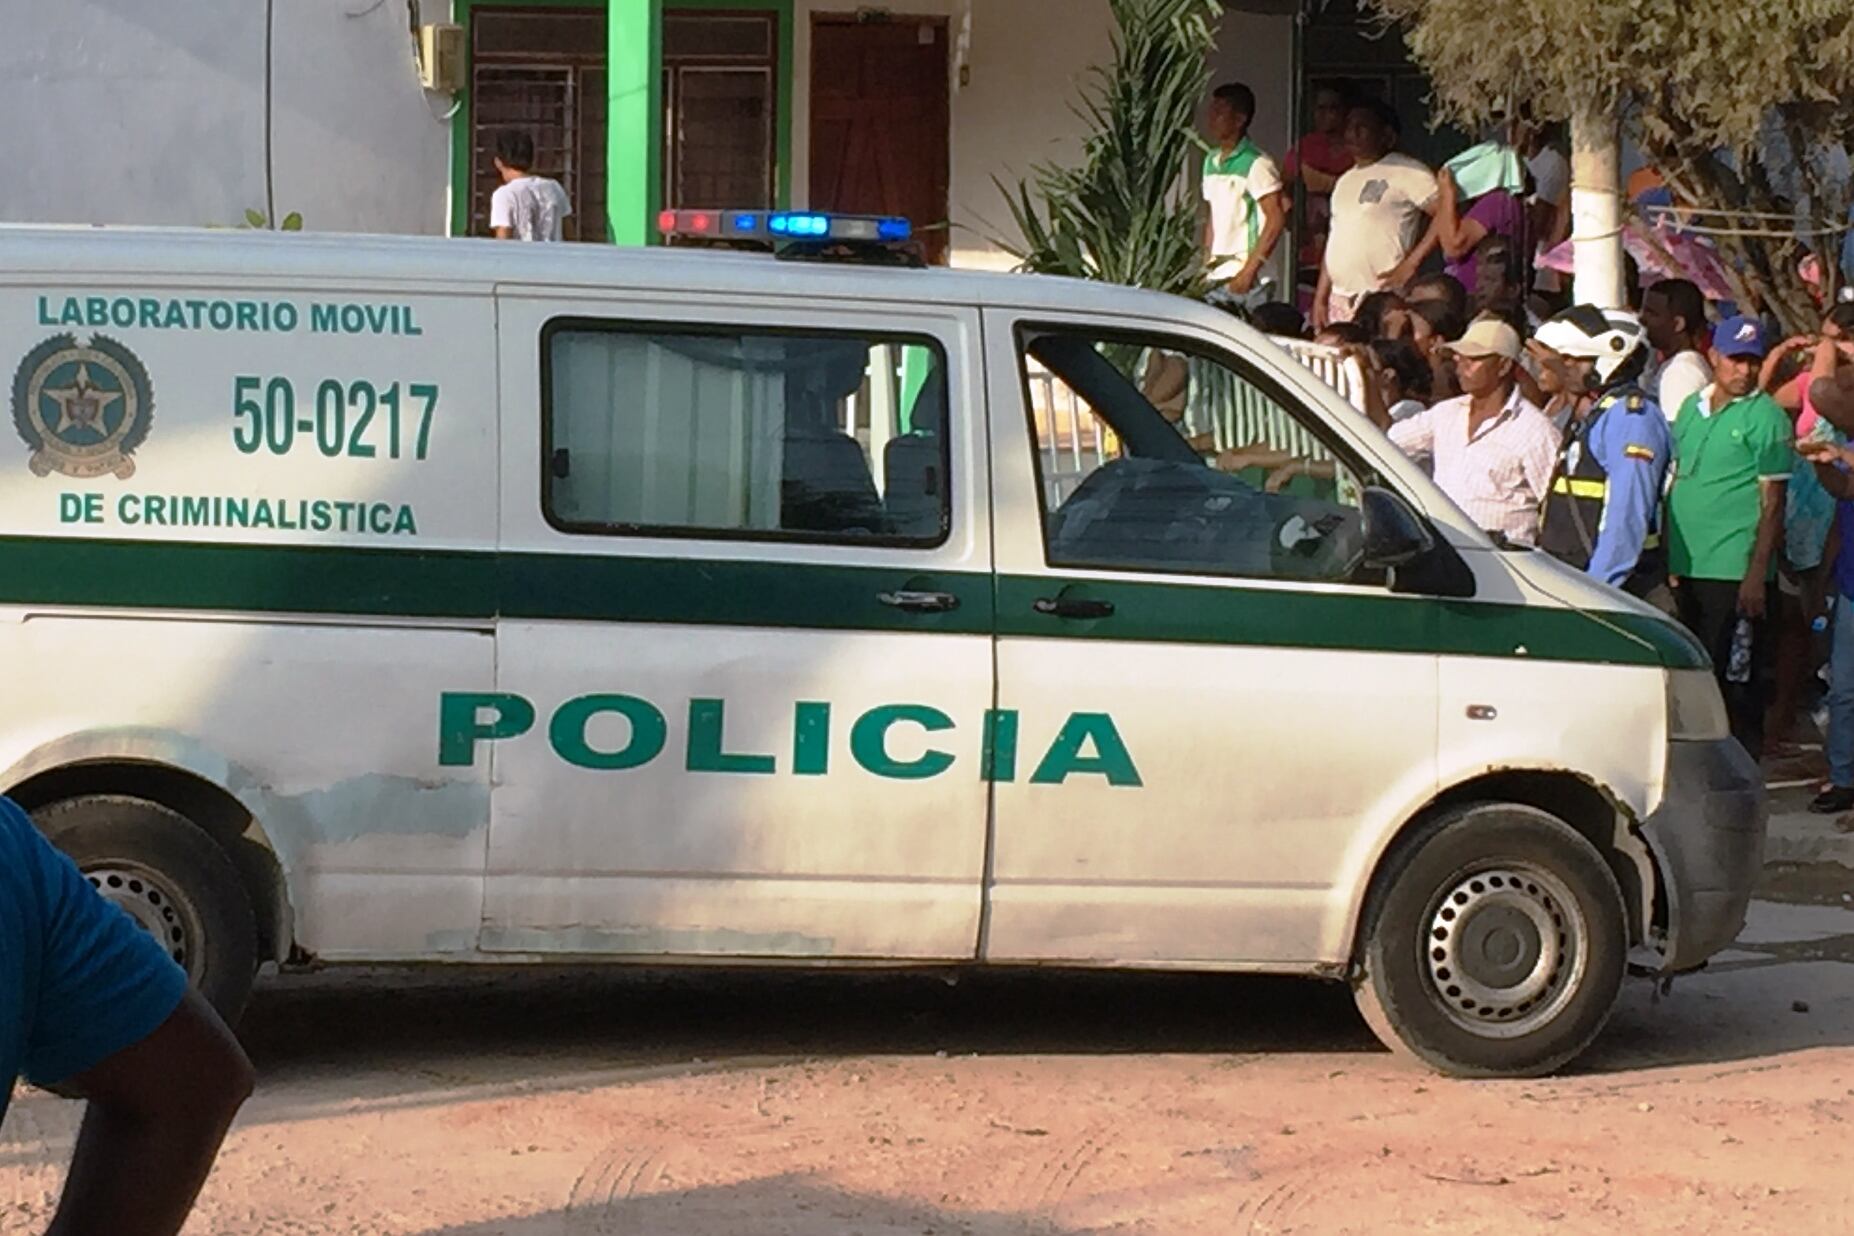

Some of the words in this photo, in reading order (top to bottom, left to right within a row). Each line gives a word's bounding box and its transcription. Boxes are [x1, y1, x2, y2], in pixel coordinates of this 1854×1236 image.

[38, 296, 298, 332] LABORATORIO
[311, 305, 423, 335] MOVIL
[232, 376, 439, 460] 50-0217
[60, 493, 104, 524] DE
[118, 495, 417, 535] CRIMINALISTICA
[438, 692, 1143, 787] POLICIA
